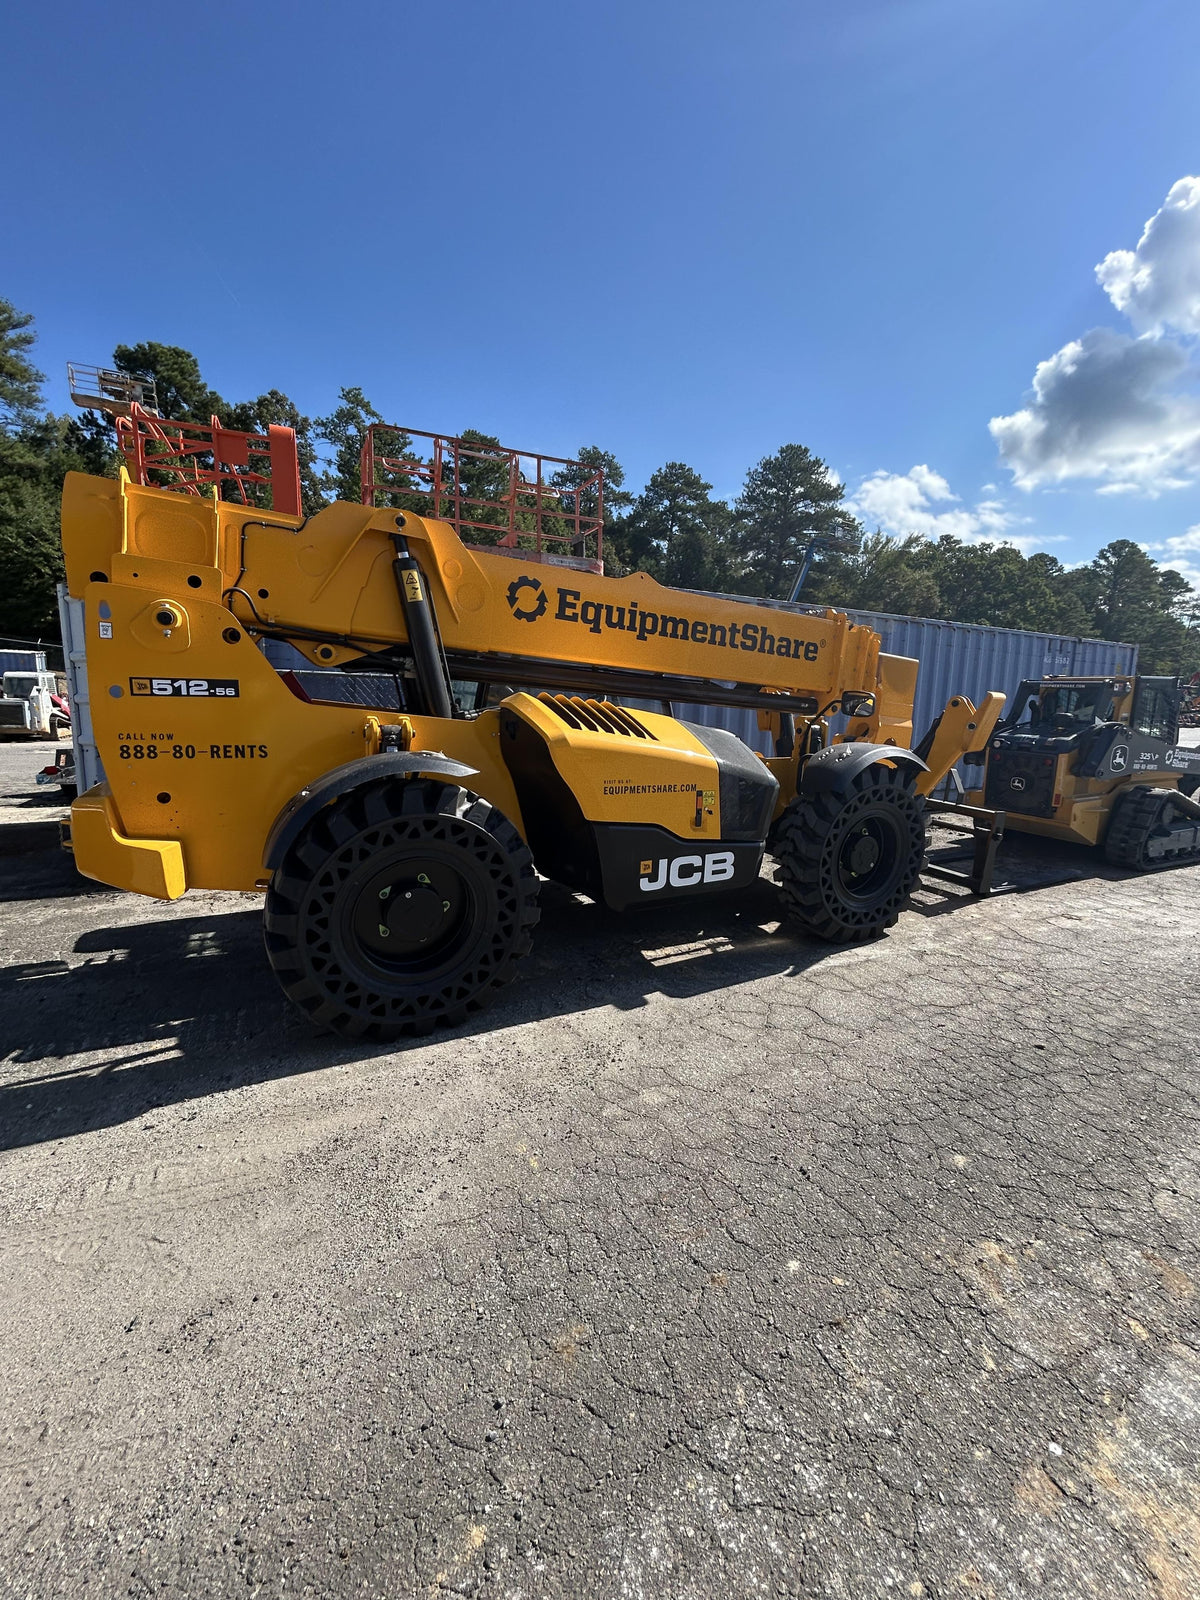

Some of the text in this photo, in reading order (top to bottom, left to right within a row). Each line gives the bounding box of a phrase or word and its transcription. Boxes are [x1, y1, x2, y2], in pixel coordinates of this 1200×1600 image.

[555, 587, 818, 662] EquipmentShare
[152, 679, 235, 696] 512-56
[118, 732, 174, 740] CALL NOW
[119, 744, 268, 759] 888-80-RENTS
[603, 784, 697, 795] EQUIPMENTSHARE.COM
[640, 851, 735, 891] JCB
